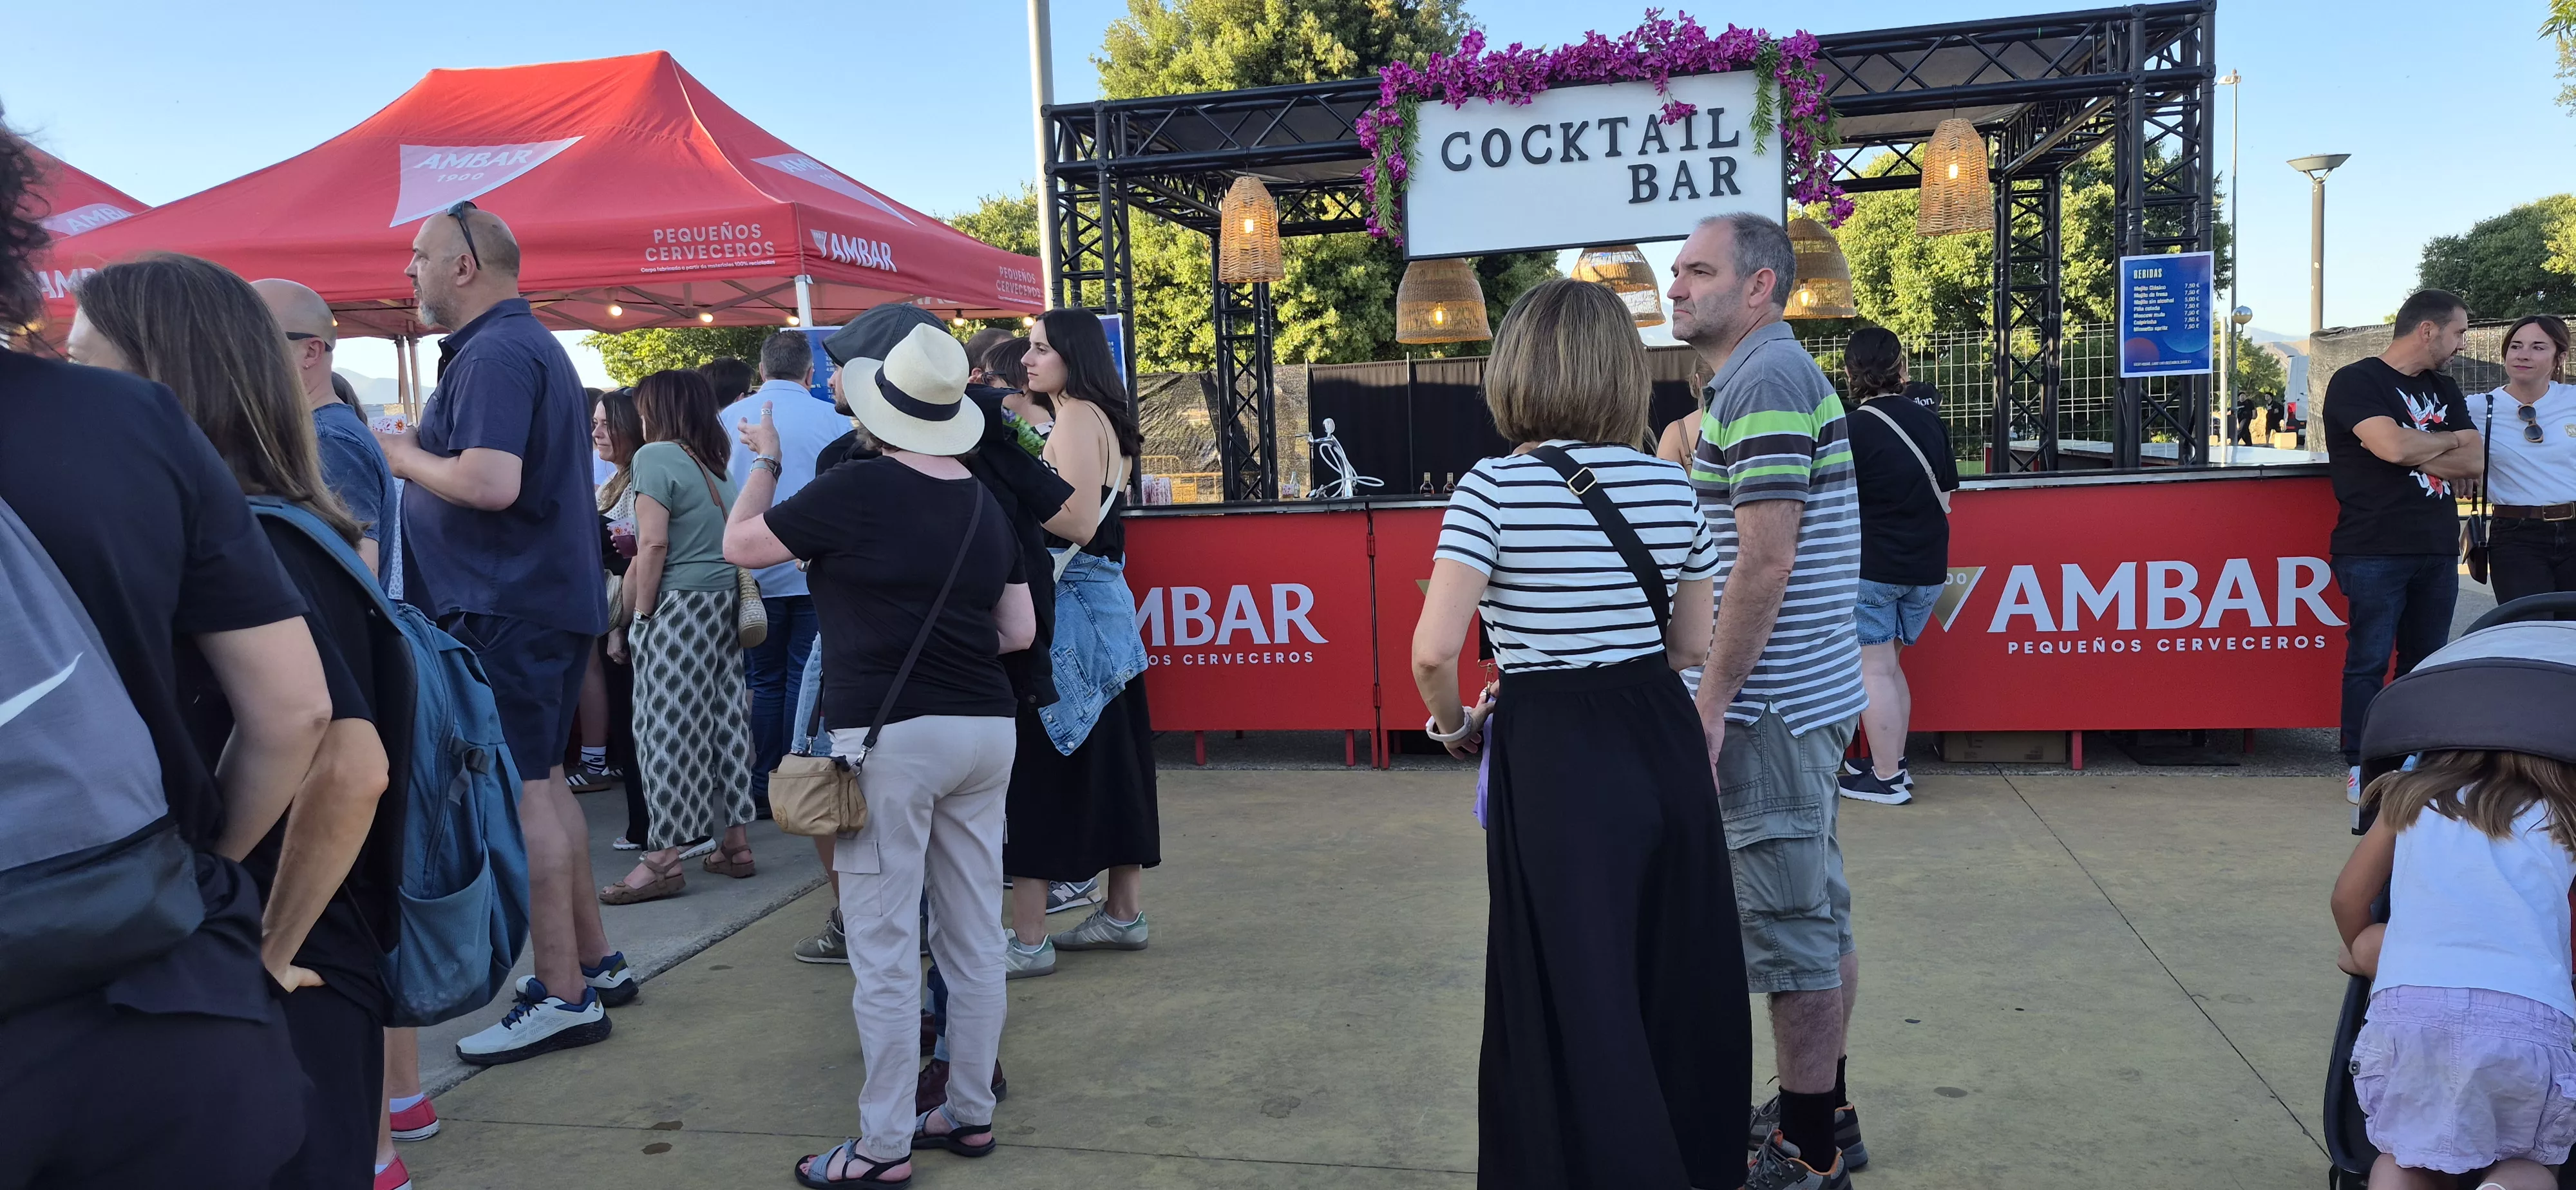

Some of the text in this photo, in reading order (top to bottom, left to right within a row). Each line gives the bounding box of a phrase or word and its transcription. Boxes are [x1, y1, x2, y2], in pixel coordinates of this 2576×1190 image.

[1441, 107, 1739, 171] COCKTAIL
[413, 149, 533, 169] AMBAR
[437, 172, 484, 182] 1900
[1627, 156, 1741, 204] BAR
[654, 222, 761, 243] PEQUEÑOS
[645, 241, 775, 261] CERVECEROS
[830, 232, 898, 273] AMBAR
[999, 266, 1036, 284] PEQUEÑOS
[2134, 268, 2162, 279] BEBIDAS
[996, 279, 1041, 298] CERVECEROS
[1913, 397, 1935, 406] ilon.
[1986, 555, 2348, 633] AMBAR
[2008, 634, 2326, 654] PEQUEÑOS CERVECEROS
[1182, 651, 1314, 666] CERVECEROS
